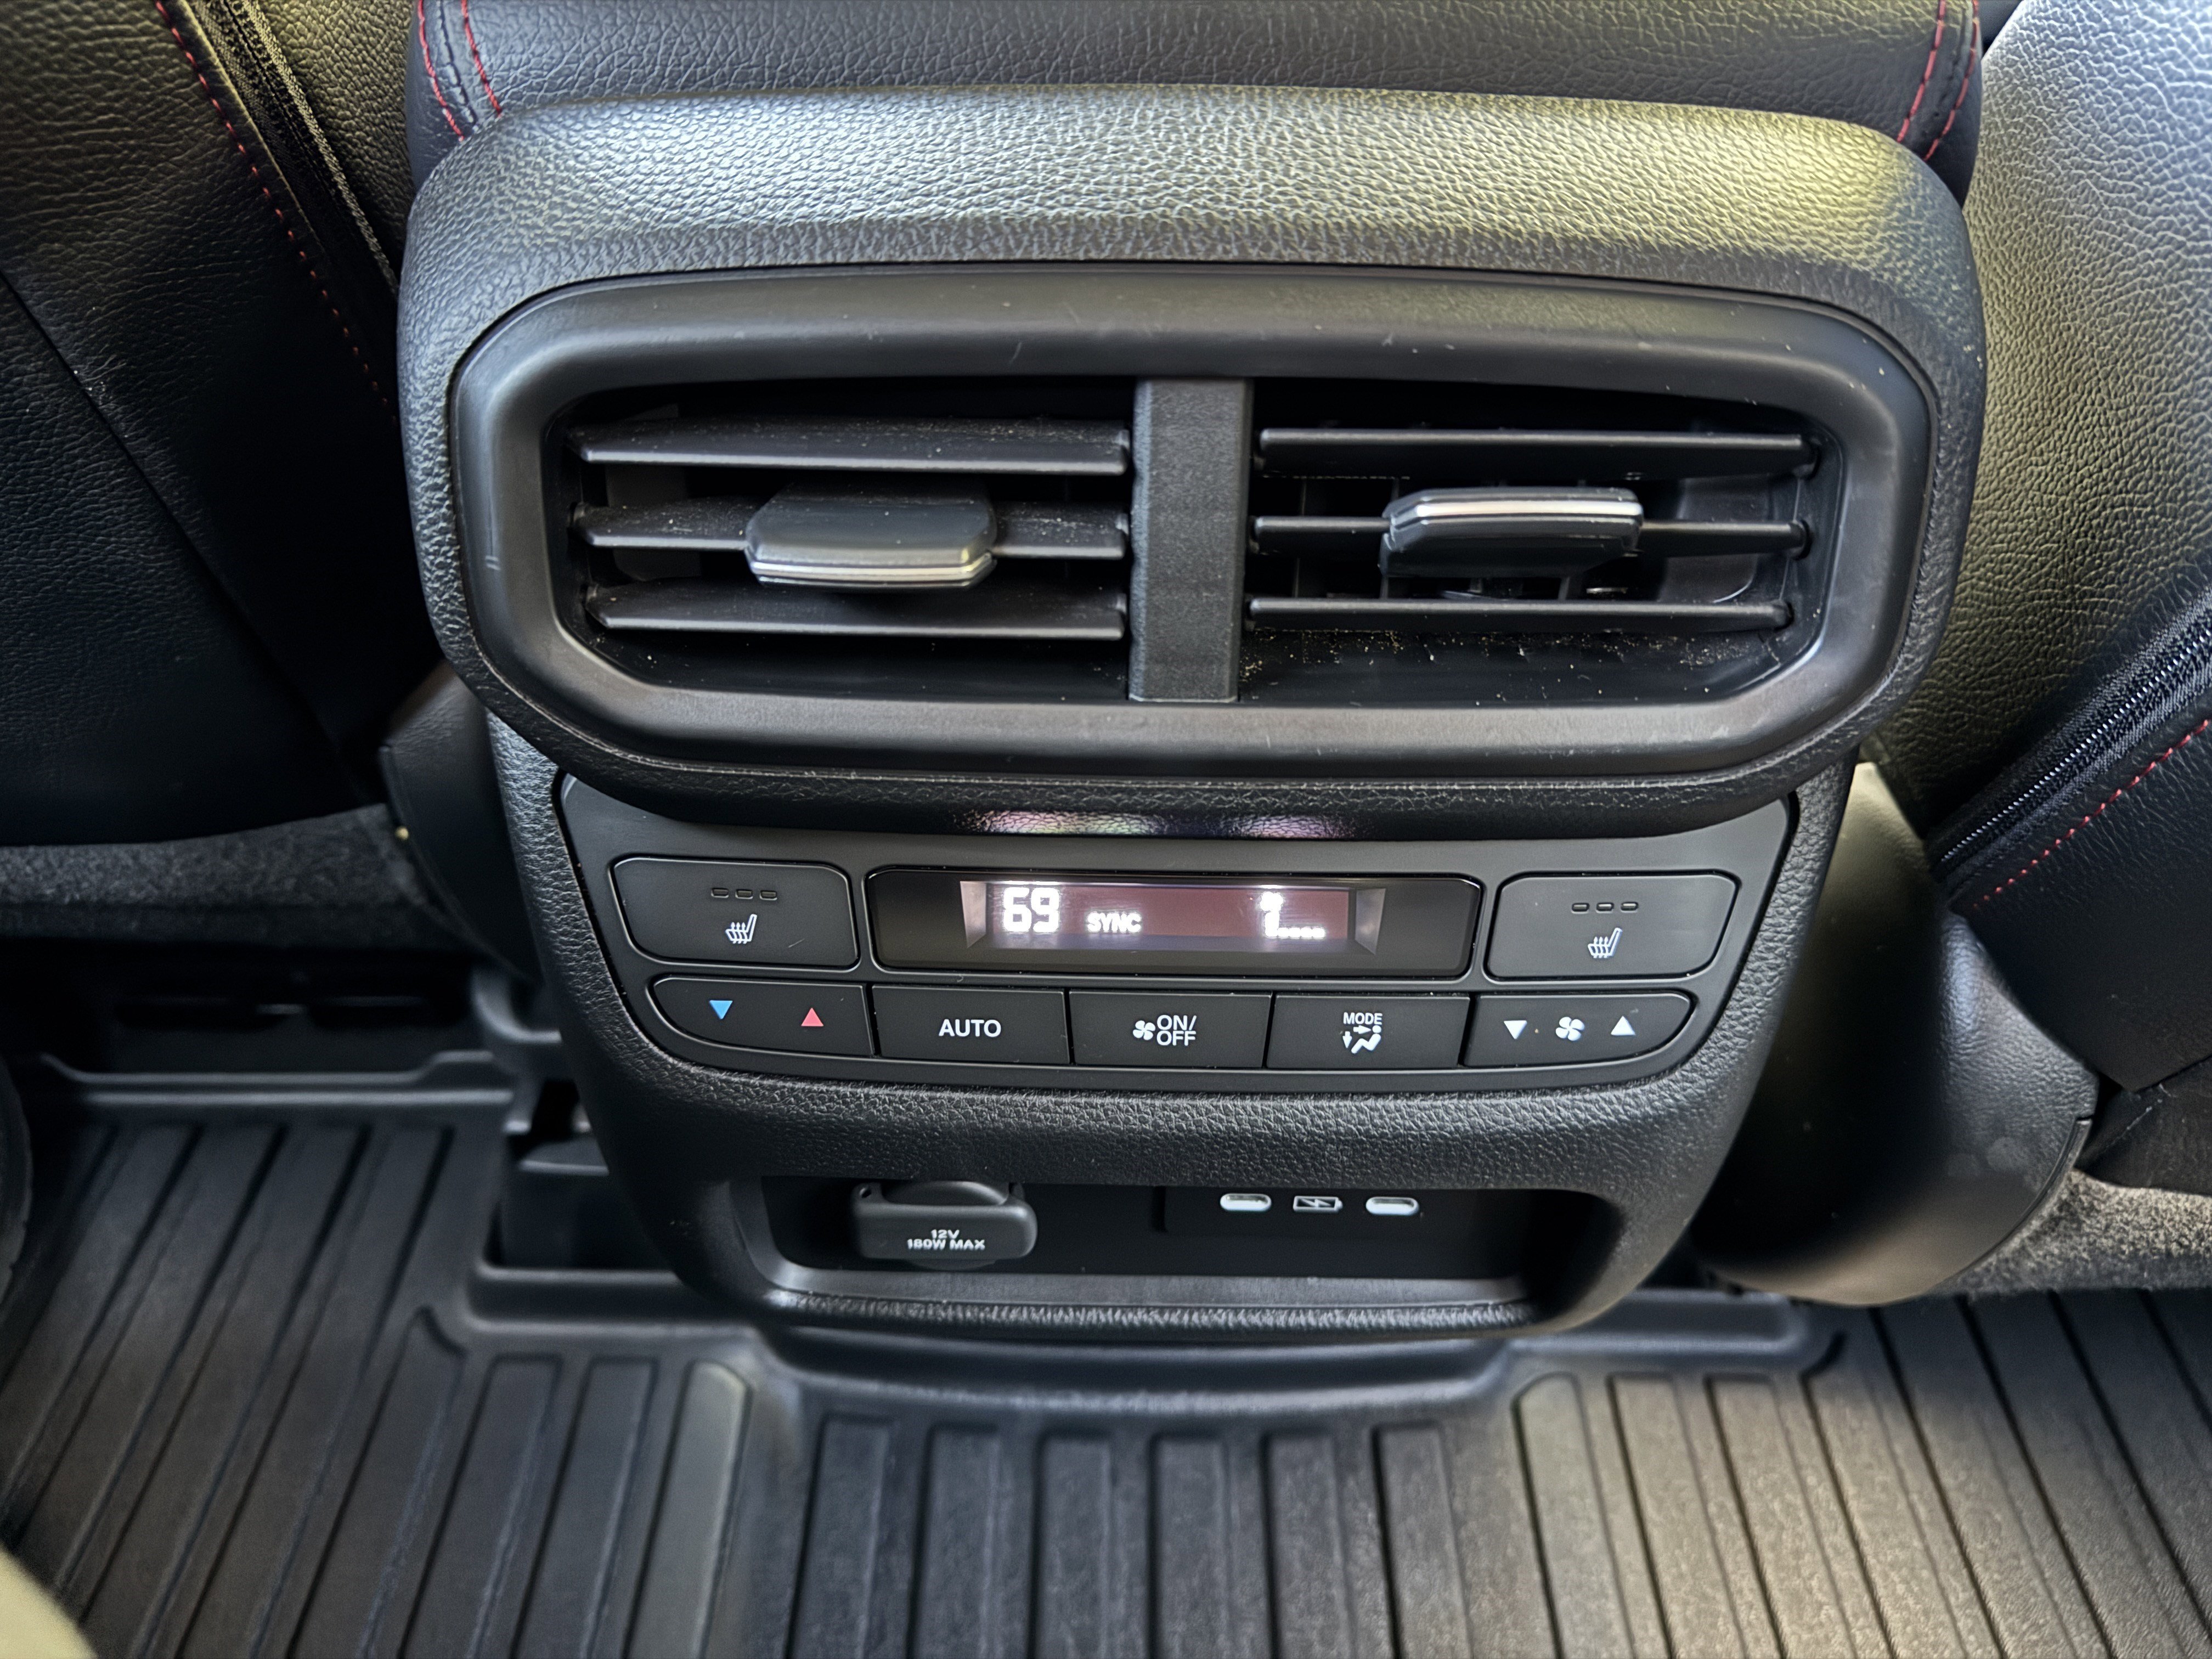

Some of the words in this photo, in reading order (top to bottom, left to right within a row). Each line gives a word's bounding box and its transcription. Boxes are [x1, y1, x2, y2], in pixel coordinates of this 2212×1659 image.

[1003, 887, 1059, 933] 69
[1087, 911, 1142, 933] SYNC
[1156, 1014, 1197, 1031] ON/
[1343, 1012, 1383, 1025] MODE
[939, 1019, 1002, 1037] AUTO
[1156, 1030, 1196, 1046] OFF
[931, 1229, 960, 1239] 12V
[907, 1238, 946, 1250] 180W
[949, 1238, 985, 1250] MAX
